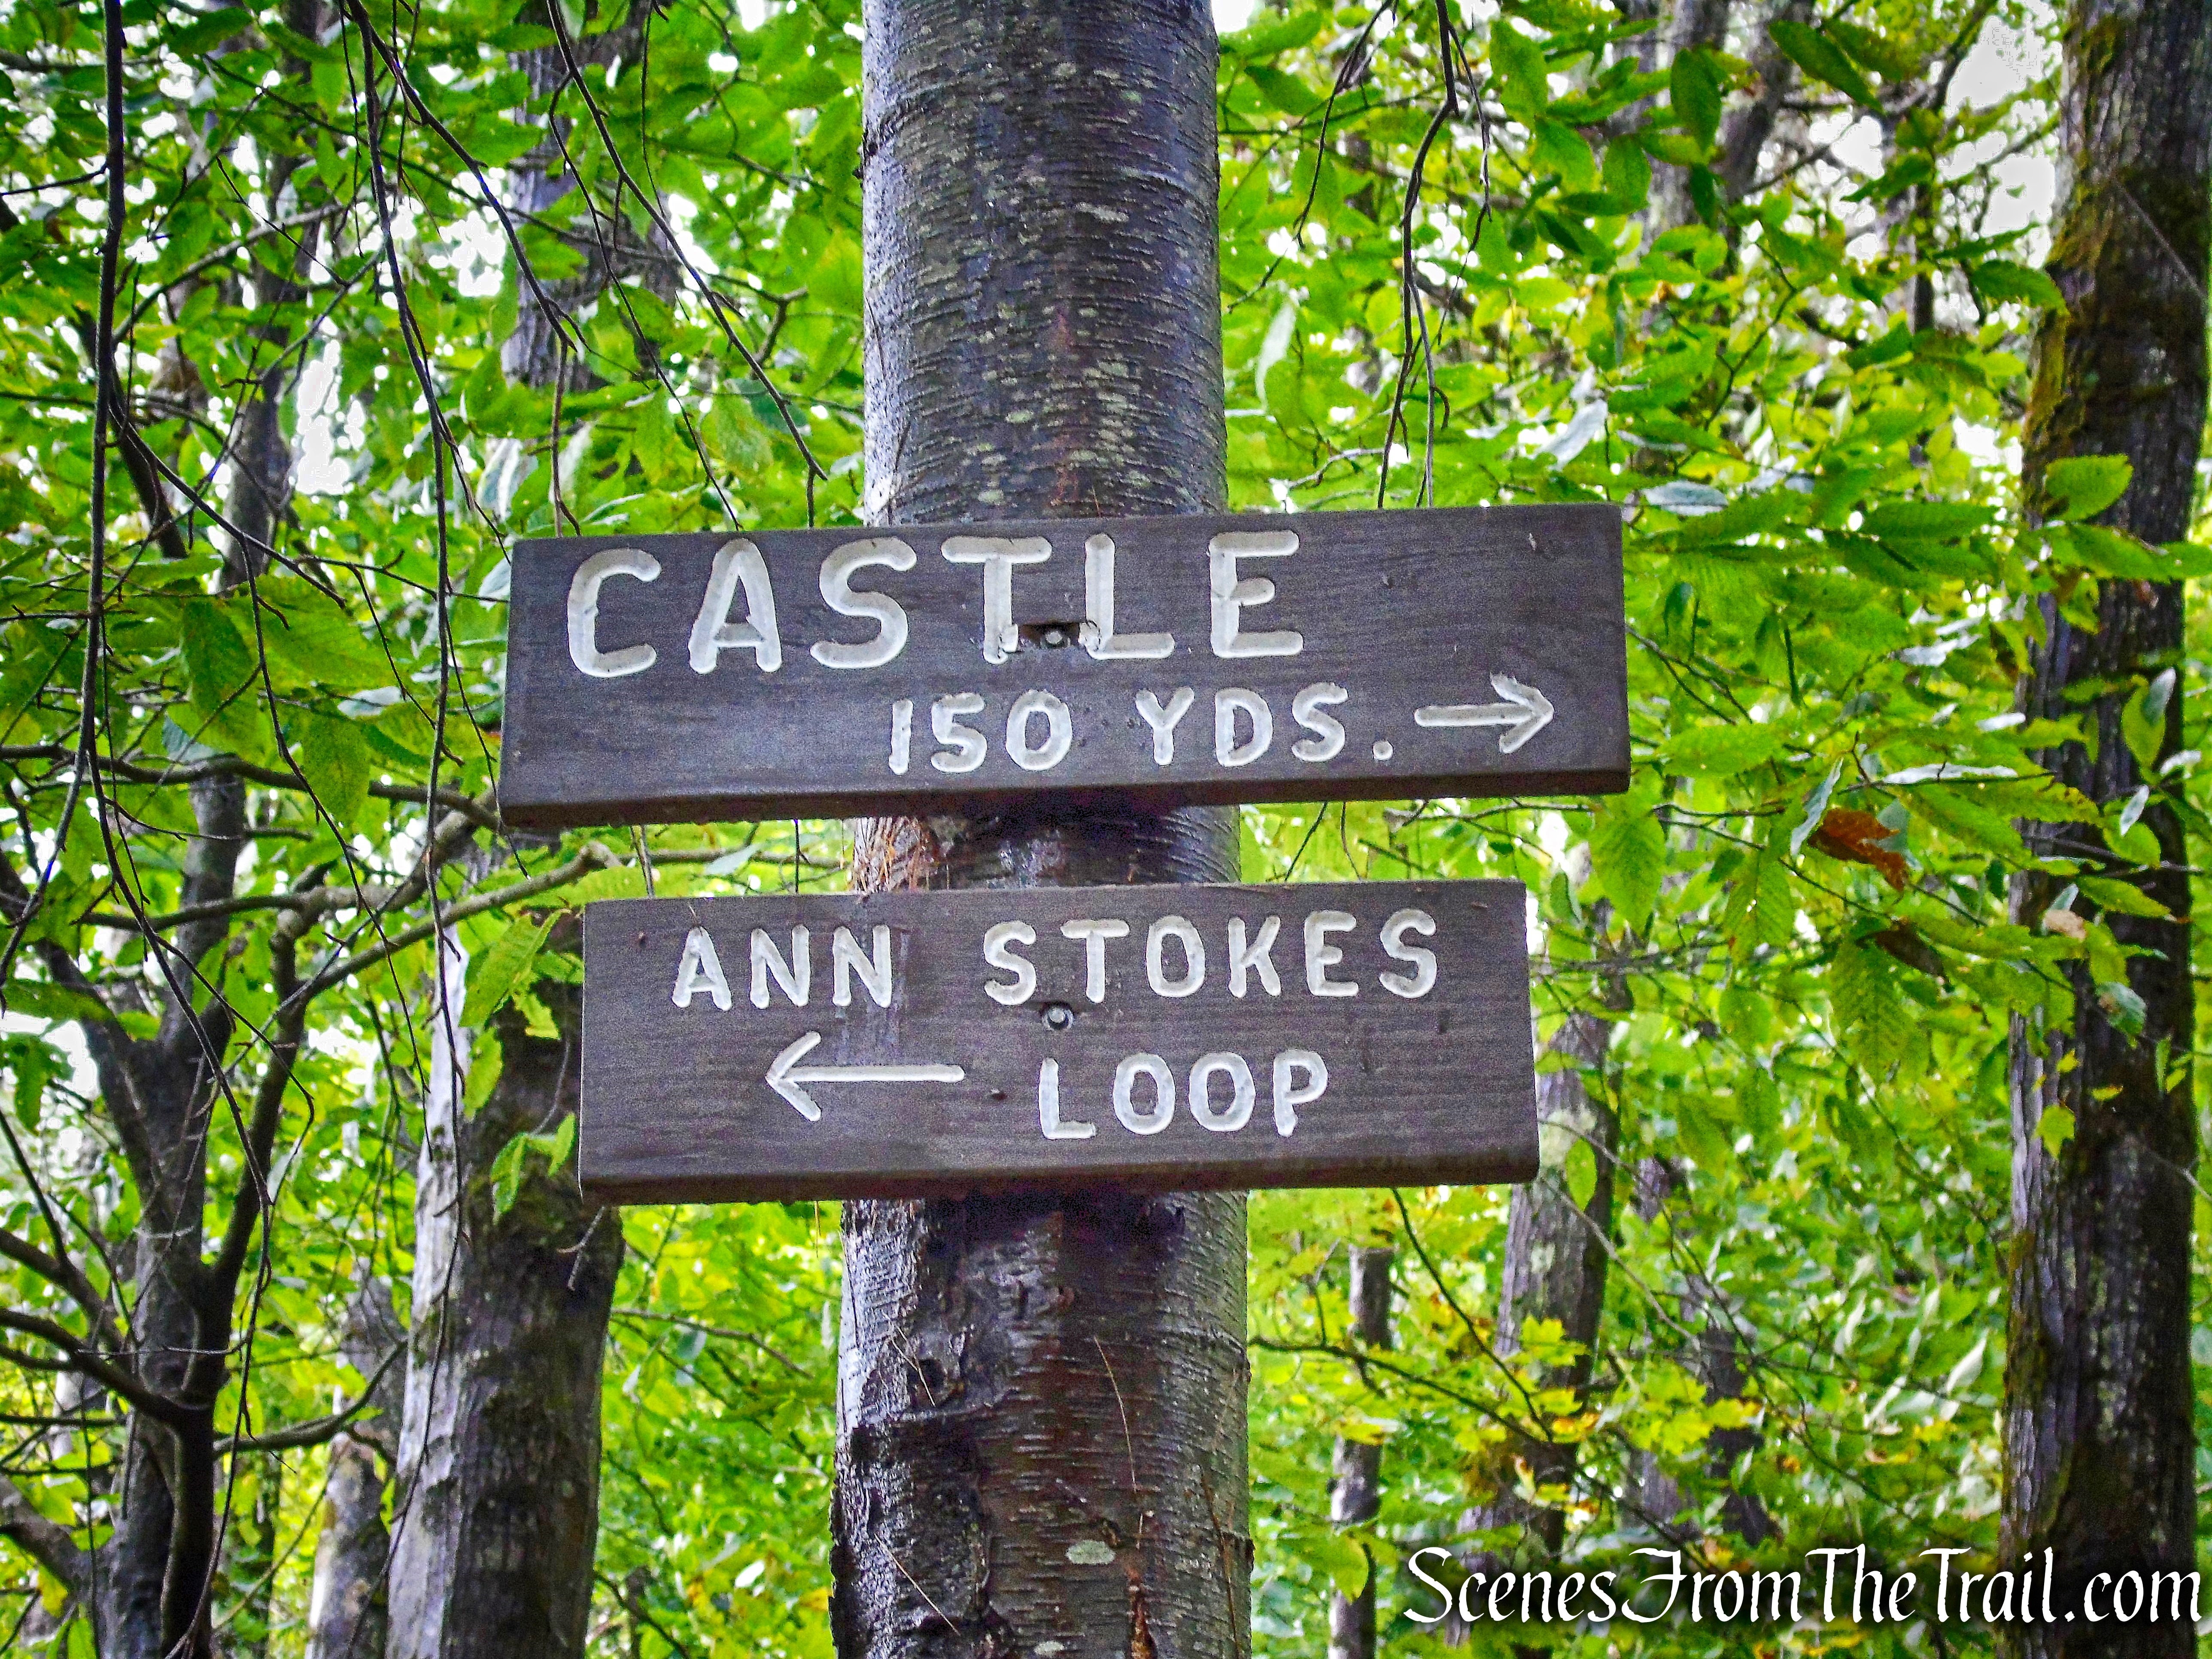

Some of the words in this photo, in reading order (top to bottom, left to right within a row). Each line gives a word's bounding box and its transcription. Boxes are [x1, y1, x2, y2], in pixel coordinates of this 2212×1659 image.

[566, 530, 1304, 678] CASTLE
[889, 688, 1072, 775] 150
[1136, 682, 1394, 767] YDS.
[672, 922, 893, 1011] ANN
[983, 908, 1439, 1006] STOKES
[1039, 1048, 1329, 1140] LOOP
